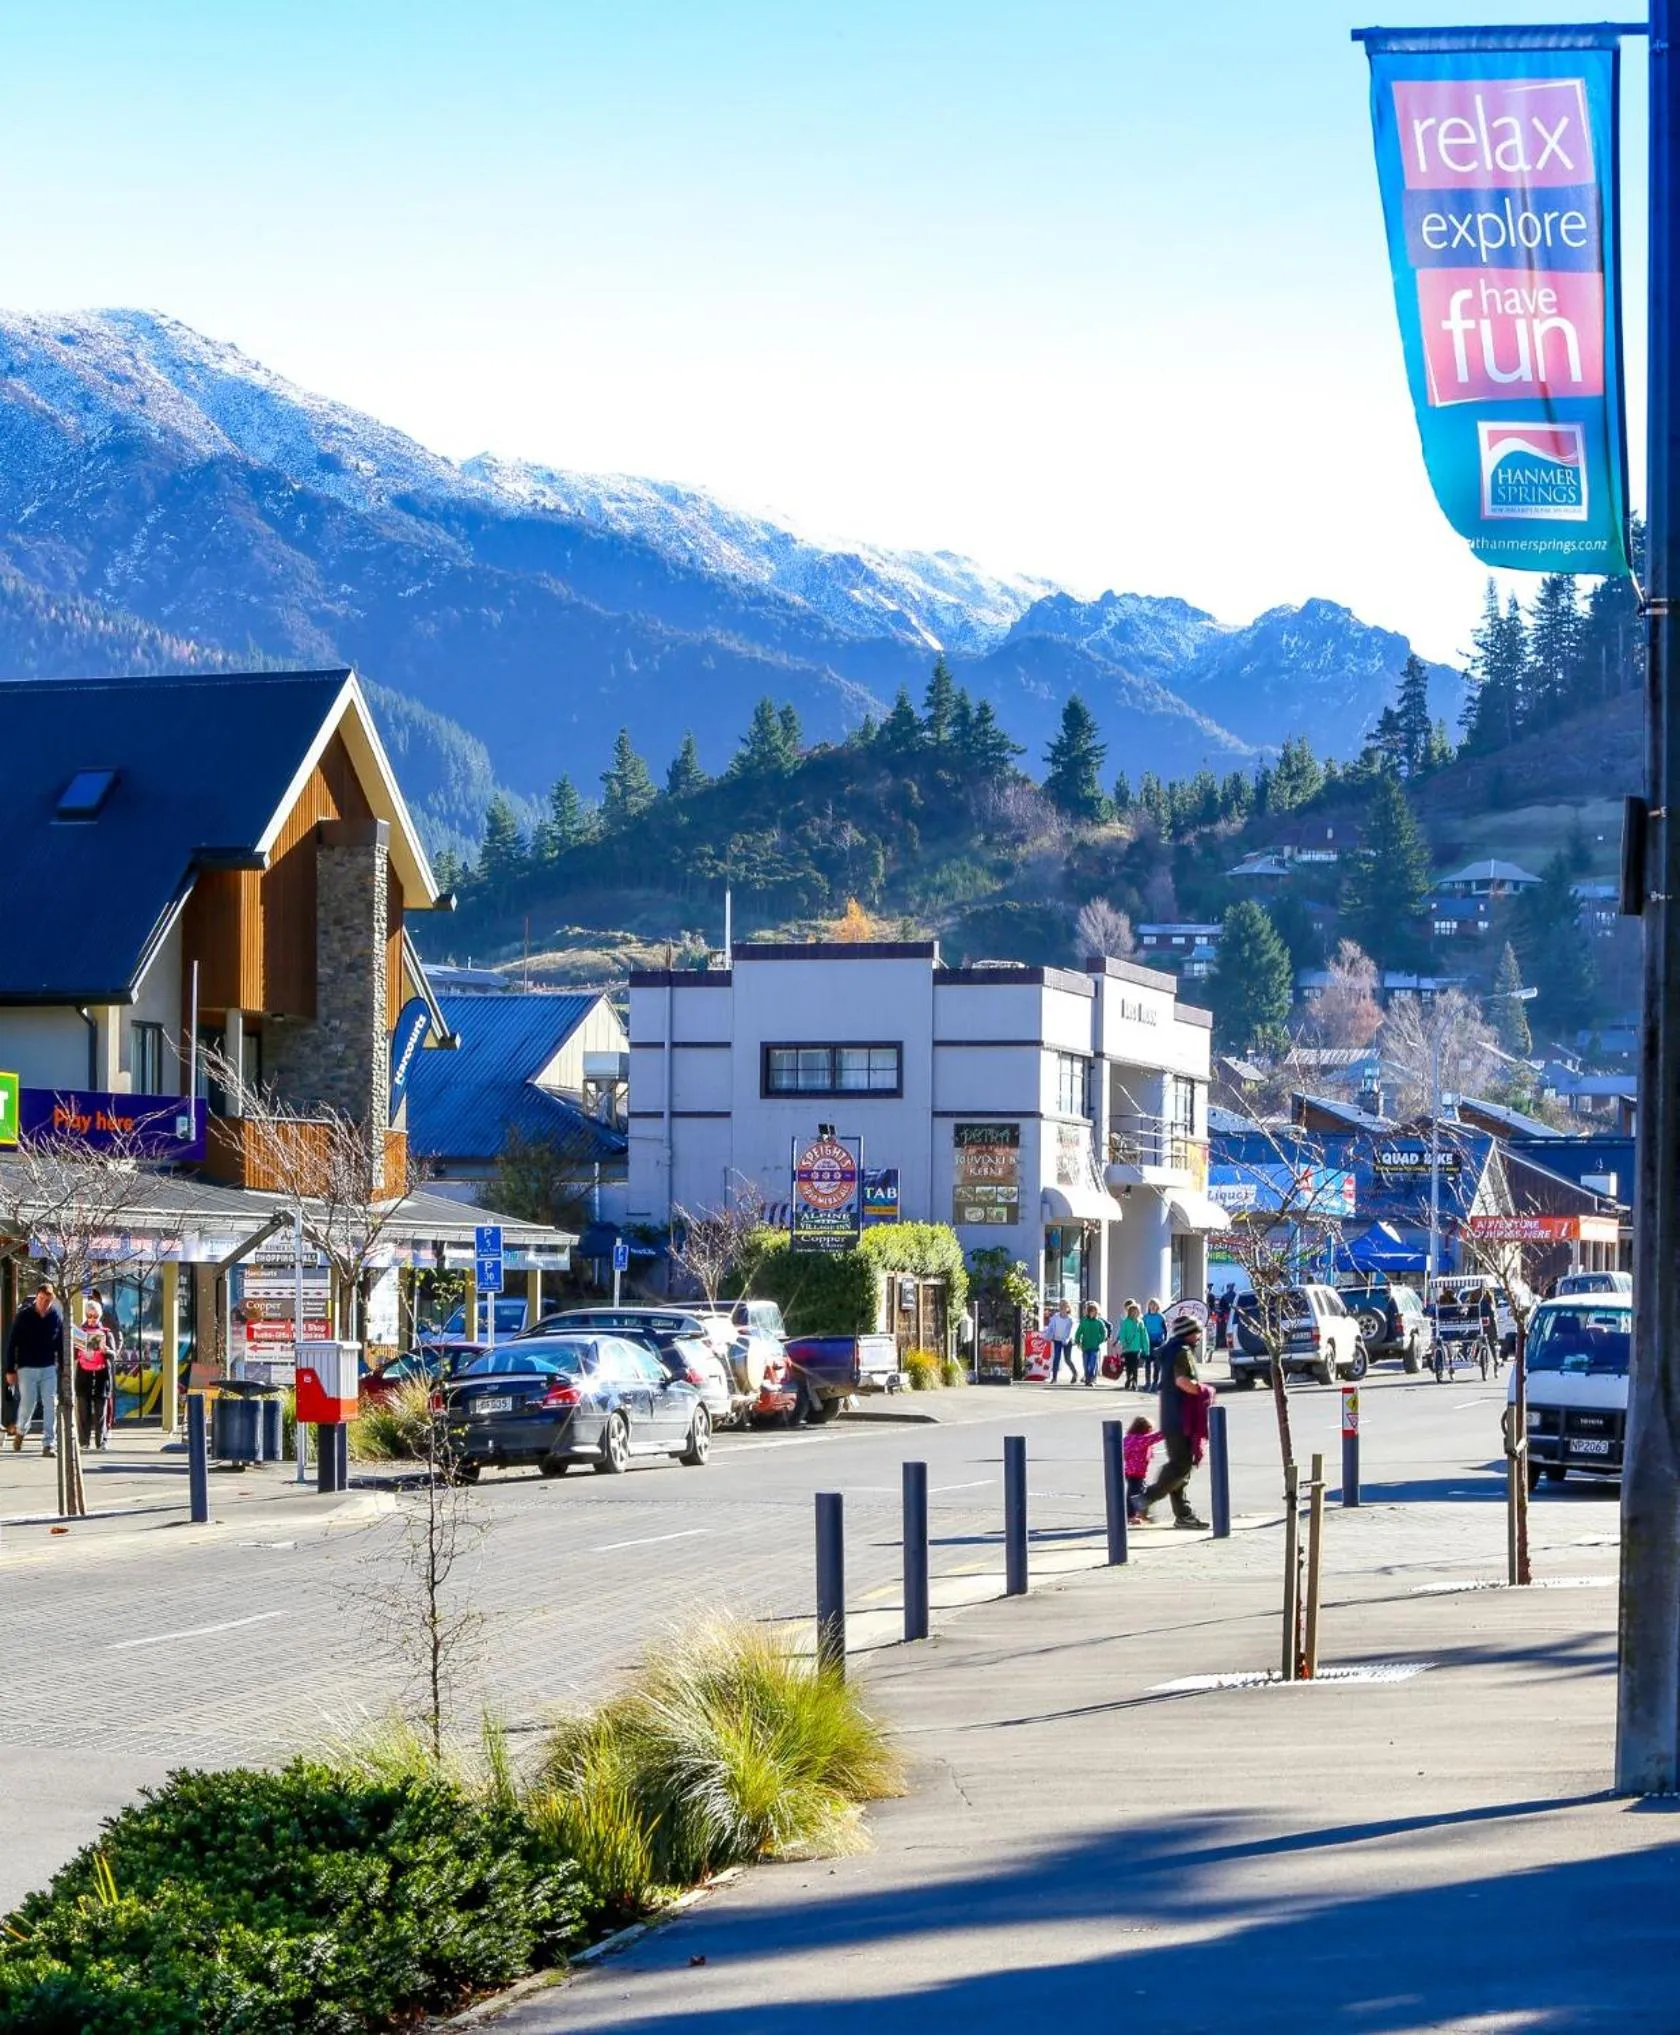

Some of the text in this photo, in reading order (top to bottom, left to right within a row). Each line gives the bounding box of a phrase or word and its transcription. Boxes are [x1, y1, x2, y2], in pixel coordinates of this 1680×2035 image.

[1413, 94, 1575, 173] relax
[1421, 197, 1588, 263] explore
[1479, 277, 1558, 315] have
[1441, 288, 1583, 384] fun
[1497, 468, 1578, 486] HANMER
[1497, 486, 1577, 503] SPRINGS
[54, 1105, 134, 1134] Play here
[1382, 1152, 1420, 1165] QUAD
[864, 1187, 898, 1199] TAB
[802, 1211, 851, 1220] ALPINE
[484, 1228, 493, 1239] P
[801, 1235, 847, 1243] Copper
[485, 1261, 494, 1272] P
